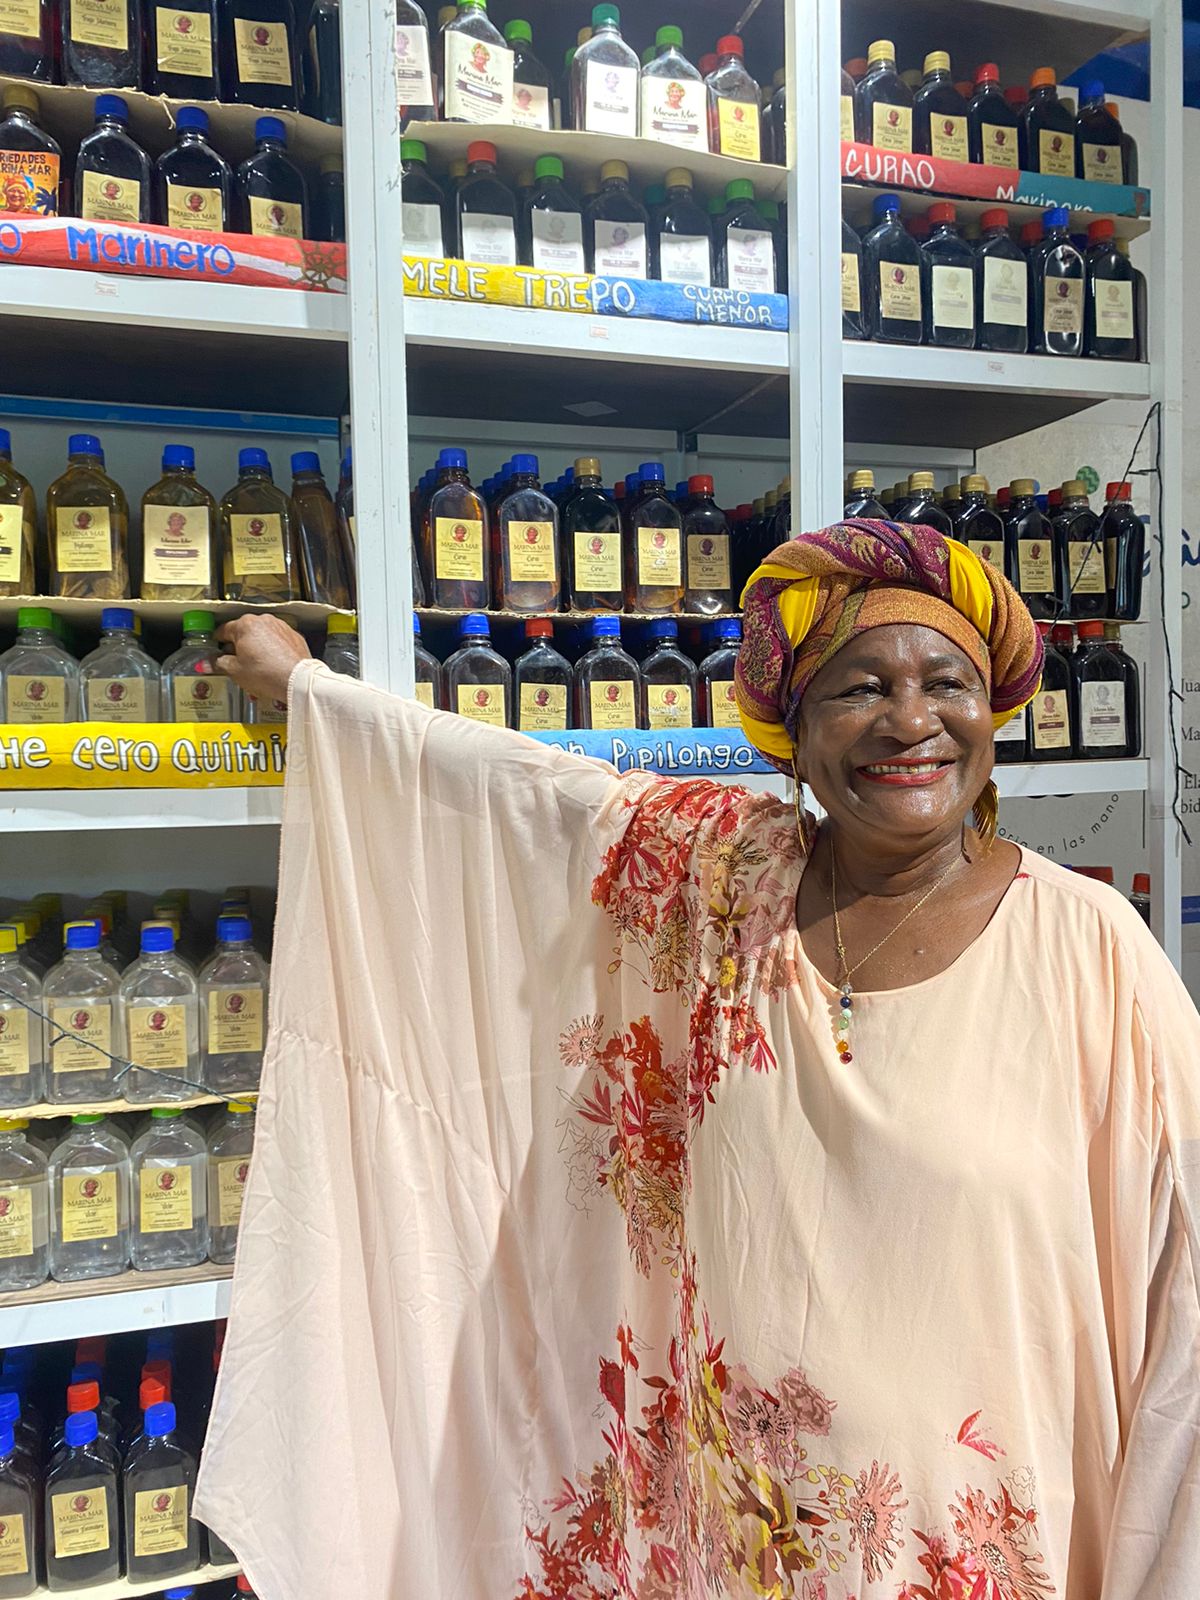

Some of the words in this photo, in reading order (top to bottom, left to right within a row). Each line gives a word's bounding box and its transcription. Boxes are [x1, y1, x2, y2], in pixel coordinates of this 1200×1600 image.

[457, 64, 483, 82] Marina
[485, 75, 503, 87] Mar
[653, 106, 679, 118] Marina
[681, 110, 698, 119] Mar
[845, 149, 935, 188] CURAO
[66, 225, 236, 275] Marinero
[514, 271, 635, 313] TREPO
[696, 301, 772, 326] MENOR
[72, 735, 160, 773] cero
[1036, 844, 1055, 855] en
[1062, 834, 1087, 852] las
[1090, 793, 1120, 835] mano
[67, 1198, 95, 1207] MARINA
